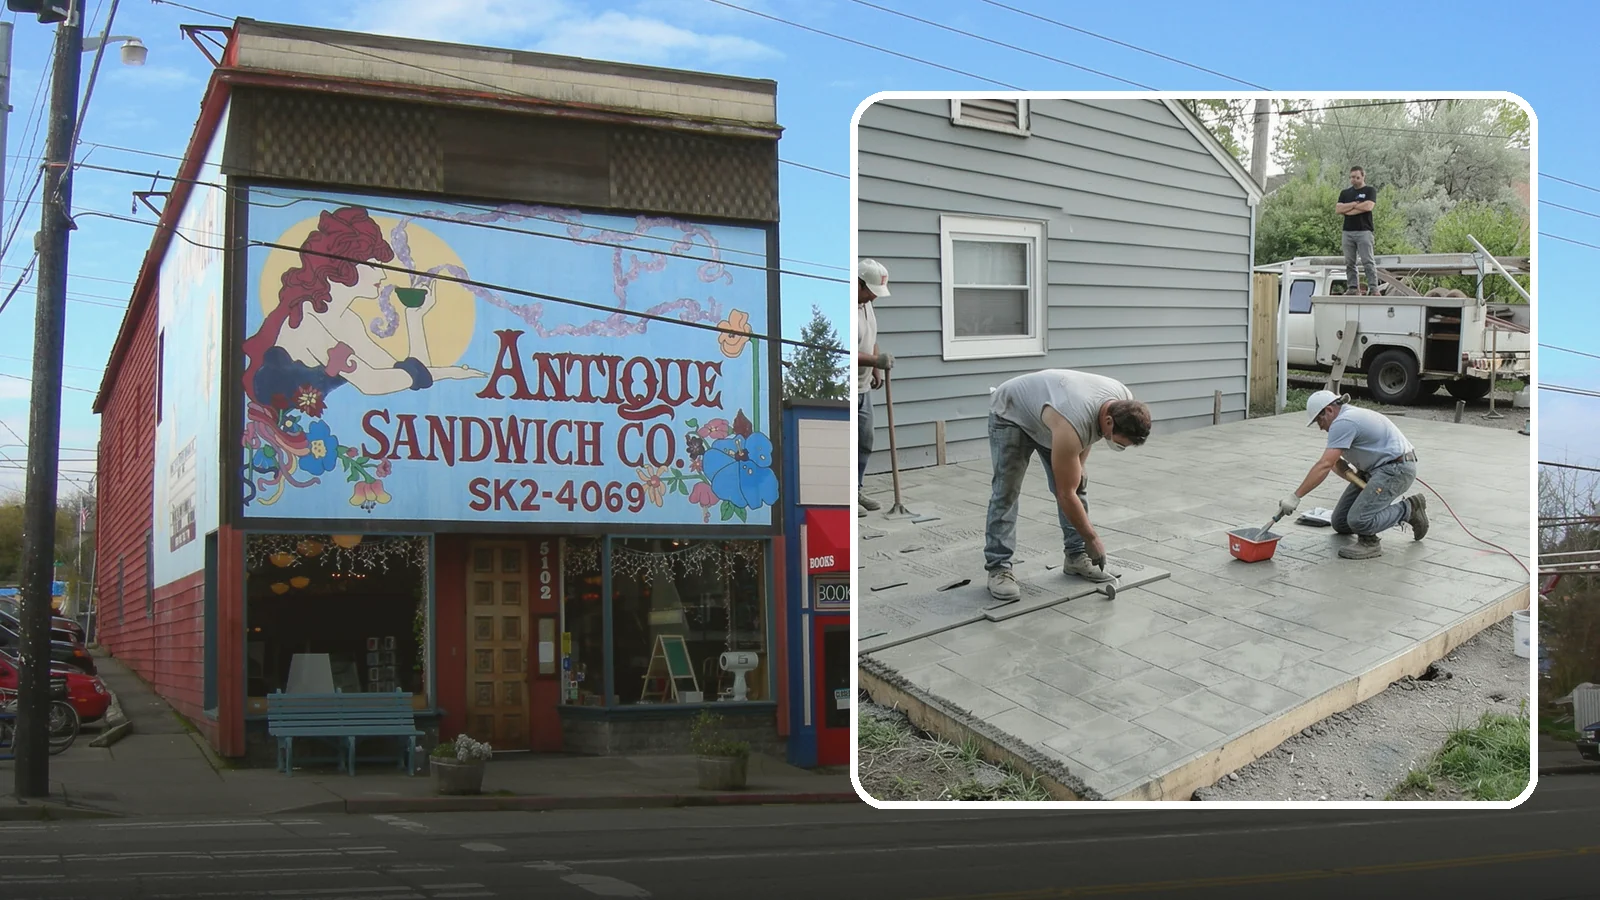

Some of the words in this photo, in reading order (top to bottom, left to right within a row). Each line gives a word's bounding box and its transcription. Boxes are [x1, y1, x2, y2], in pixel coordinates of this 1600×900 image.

[475, 329, 724, 420] ANTIQUE
[361, 408, 605, 467] SANDWICH
[616, 421, 685, 468] CO.
[468, 477, 646, 513] SK2-4069
[539, 541, 552, 600] 5102
[809, 555, 835, 569] BOOKS
